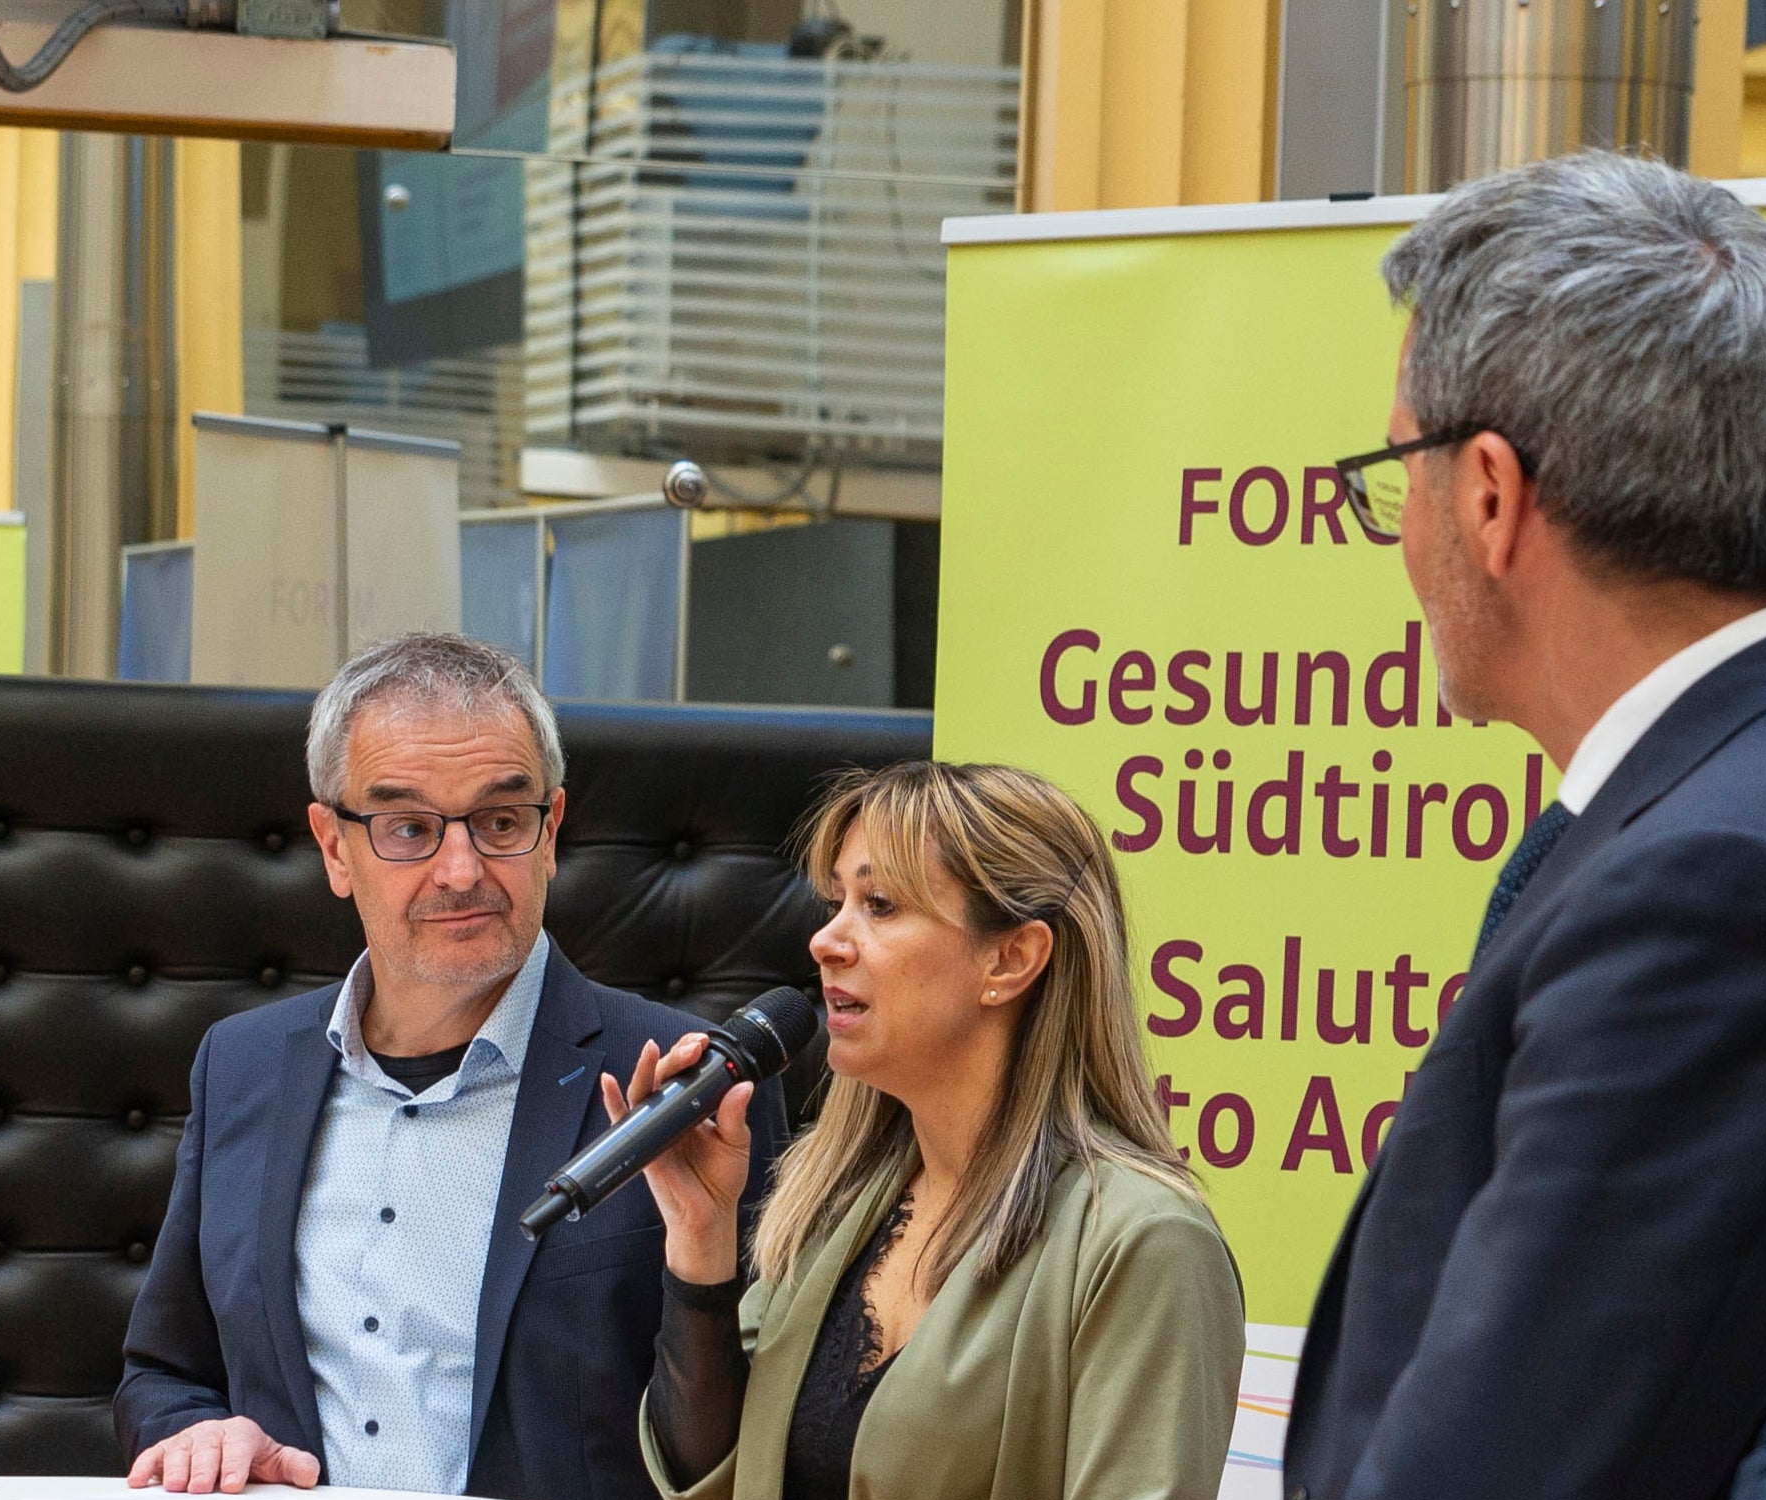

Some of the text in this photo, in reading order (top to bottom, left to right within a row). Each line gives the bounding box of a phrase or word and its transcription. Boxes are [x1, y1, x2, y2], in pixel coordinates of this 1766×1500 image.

[1179, 465, 1402, 546] FOR
[270, 576, 375, 629] FORM
[1039, 620, 1487, 729] Gesund
[1112, 747, 1544, 862] Südtirol
